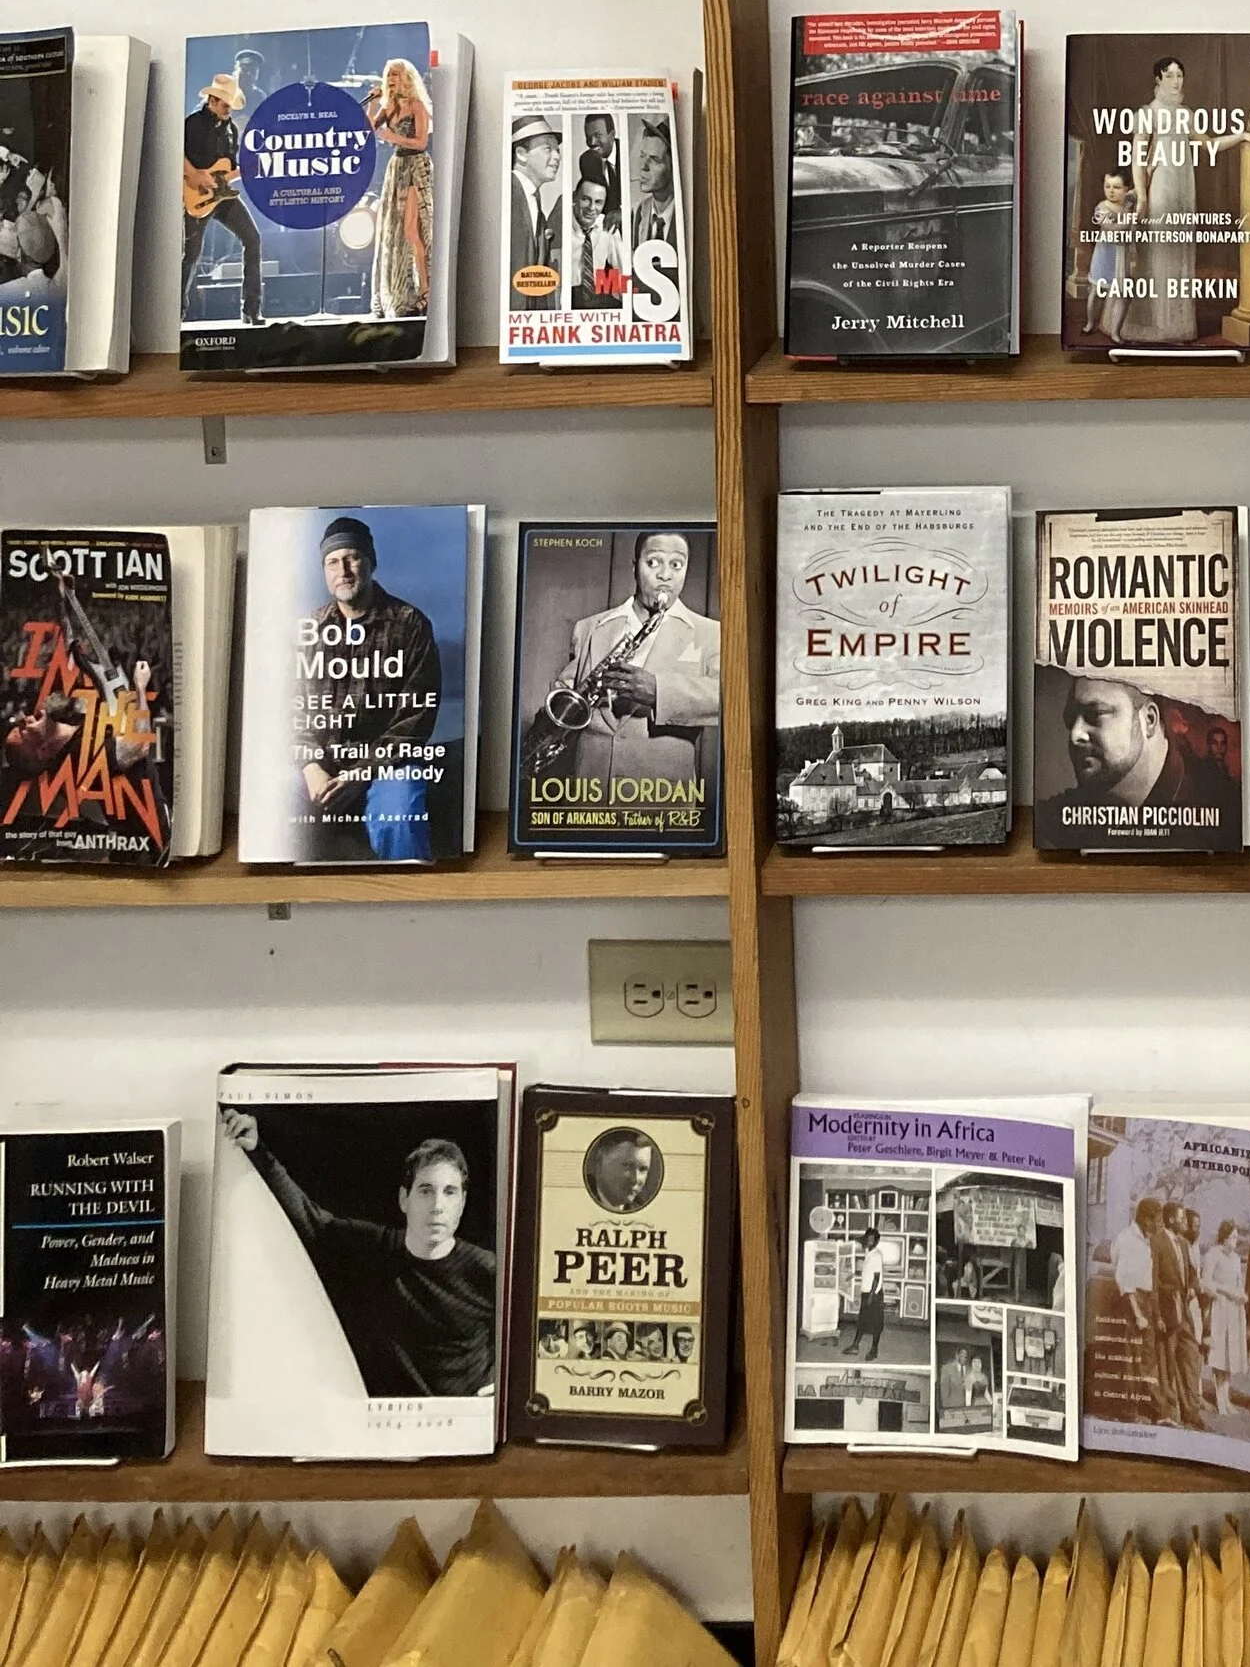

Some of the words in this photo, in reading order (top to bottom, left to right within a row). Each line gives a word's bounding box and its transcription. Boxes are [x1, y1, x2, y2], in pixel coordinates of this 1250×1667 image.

[1093, 108, 1245, 135] WONDROUS
[244, 129, 370, 161] Country
[1118, 140, 1220, 167] BEAUTY
[255, 149, 360, 179] Music
[509, 325, 584, 346] FRANK
[591, 323, 681, 344] SINATRA
[832, 315, 879, 333] Jerry
[886, 313, 964, 329] Mitchell
[805, 565, 972, 596] TWILIGHT
[1050, 553, 1229, 599] ROMANTIC
[879, 594, 901, 617] of
[296, 618, 366, 647] Bob
[807, 629, 971, 657] EMPIRE
[1049, 617, 1229, 668] VIOLENCE
[295, 649, 404, 681] Mould
[796, 697, 829, 707] GREG
[833, 696, 862, 706] KING
[888, 696, 928, 706] PENNY
[933, 696, 981, 706] WILSON
[530, 778, 602, 803] LOUIS
[609, 778, 704, 805] JORDAN
[75, 835, 149, 851] ANTHRAX
[809, 1113, 909, 1141] Modernity
[915, 1119, 931, 1137] in
[938, 1120, 995, 1143] Africa
[30, 1181, 107, 1196] RUNNING
[111, 1179, 154, 1194] WITH
[69, 1201, 106, 1216] THE
[106, 1200, 155, 1215] DEVIL
[575, 1226, 667, 1250] RALPH
[553, 1249, 688, 1288] PEER
